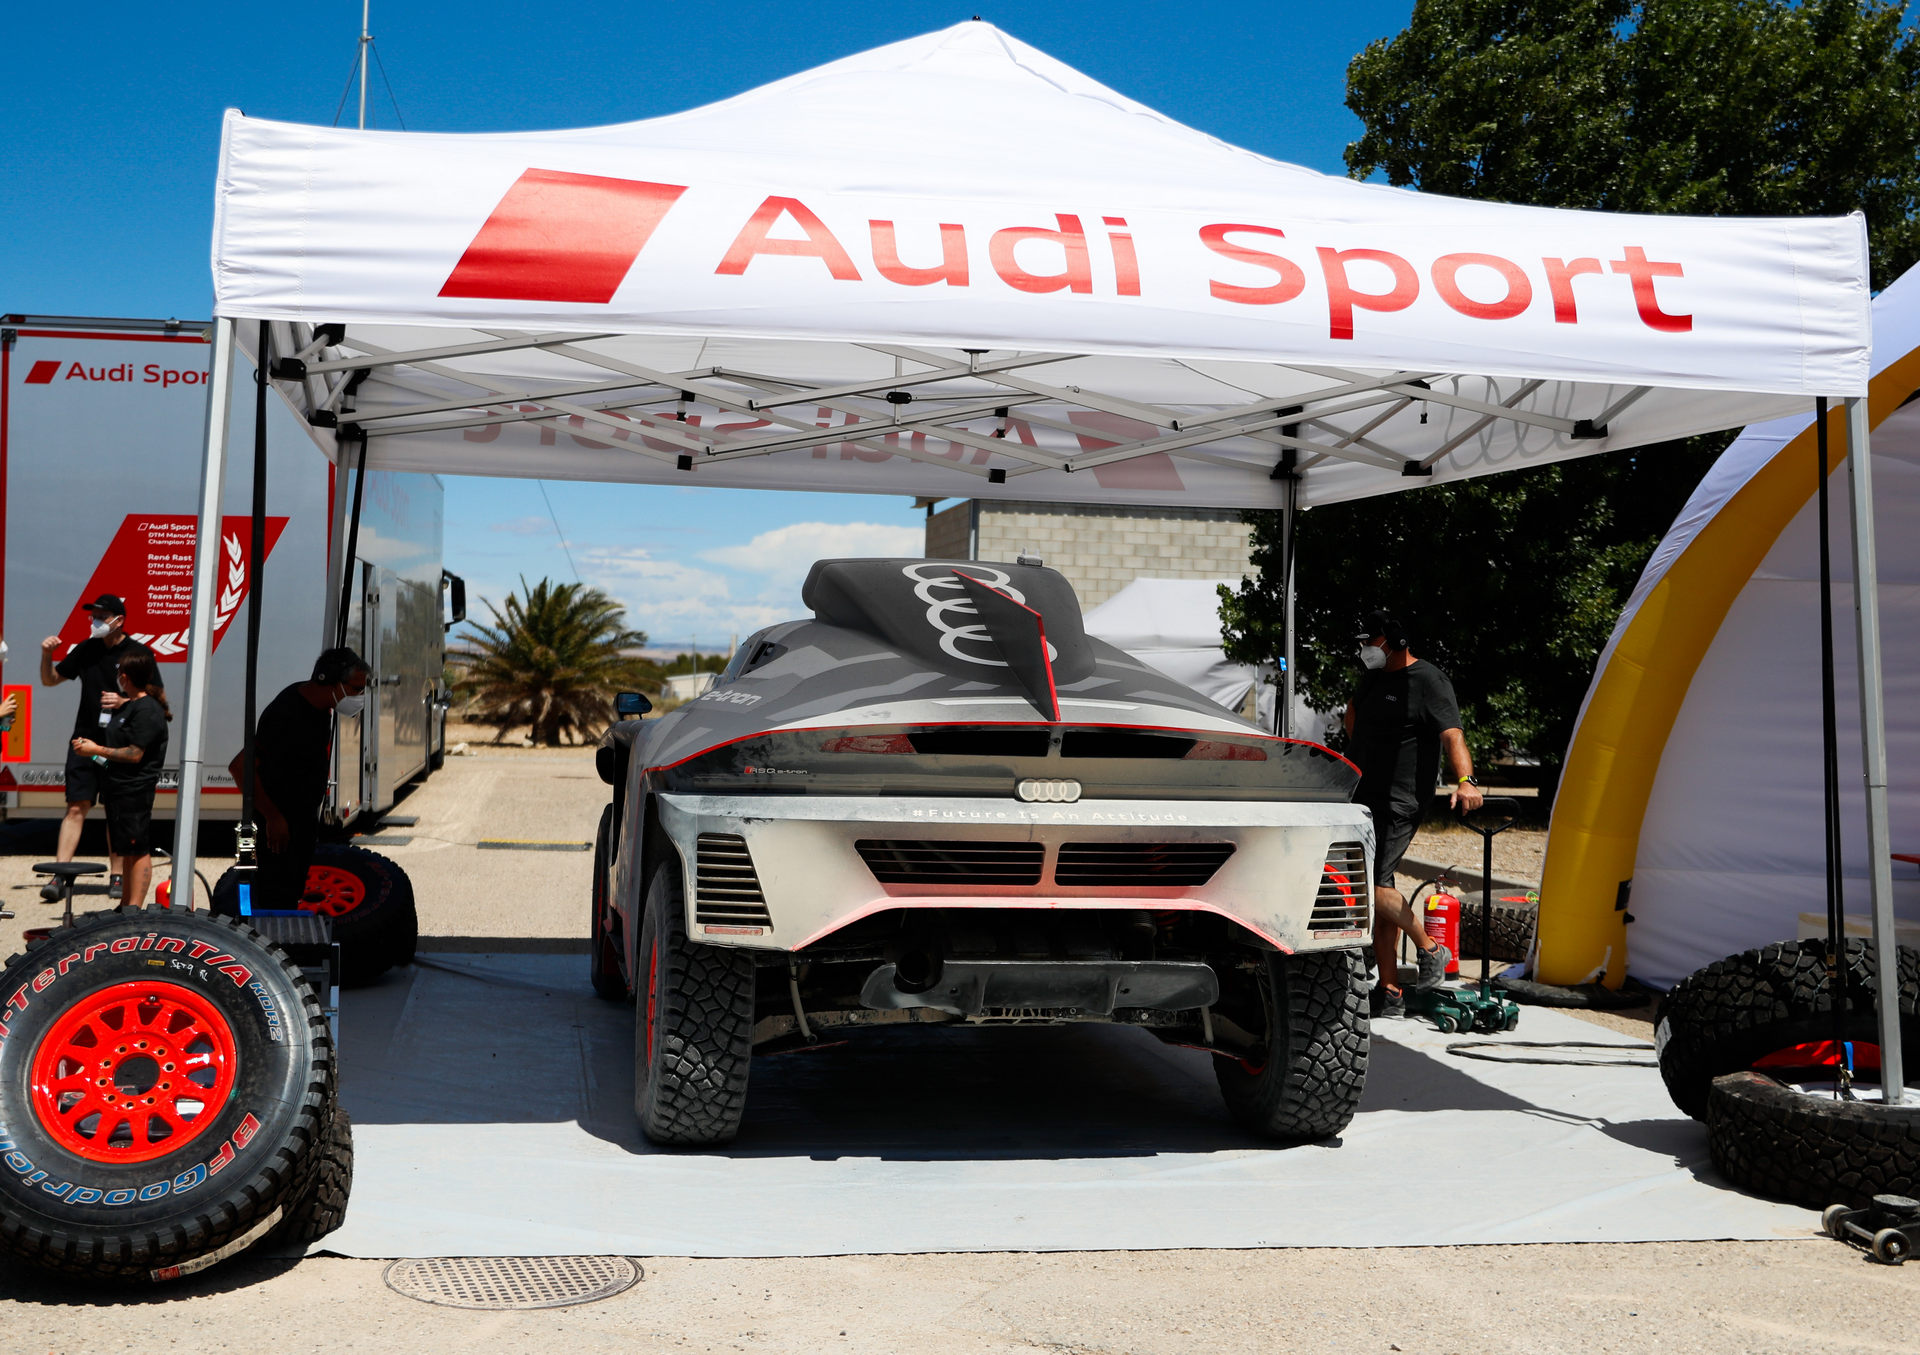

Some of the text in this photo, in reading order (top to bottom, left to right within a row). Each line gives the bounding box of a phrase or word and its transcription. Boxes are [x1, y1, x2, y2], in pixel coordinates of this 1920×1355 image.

[714, 195, 1693, 341] Audi Sport
[65, 362, 209, 389] Audi Spor
[170, 523, 195, 531] Sport
[170, 584, 193, 593] Spor
[147, 592, 172, 600] Team
[912, 809, 1189, 822] #Future Is An Attitude
